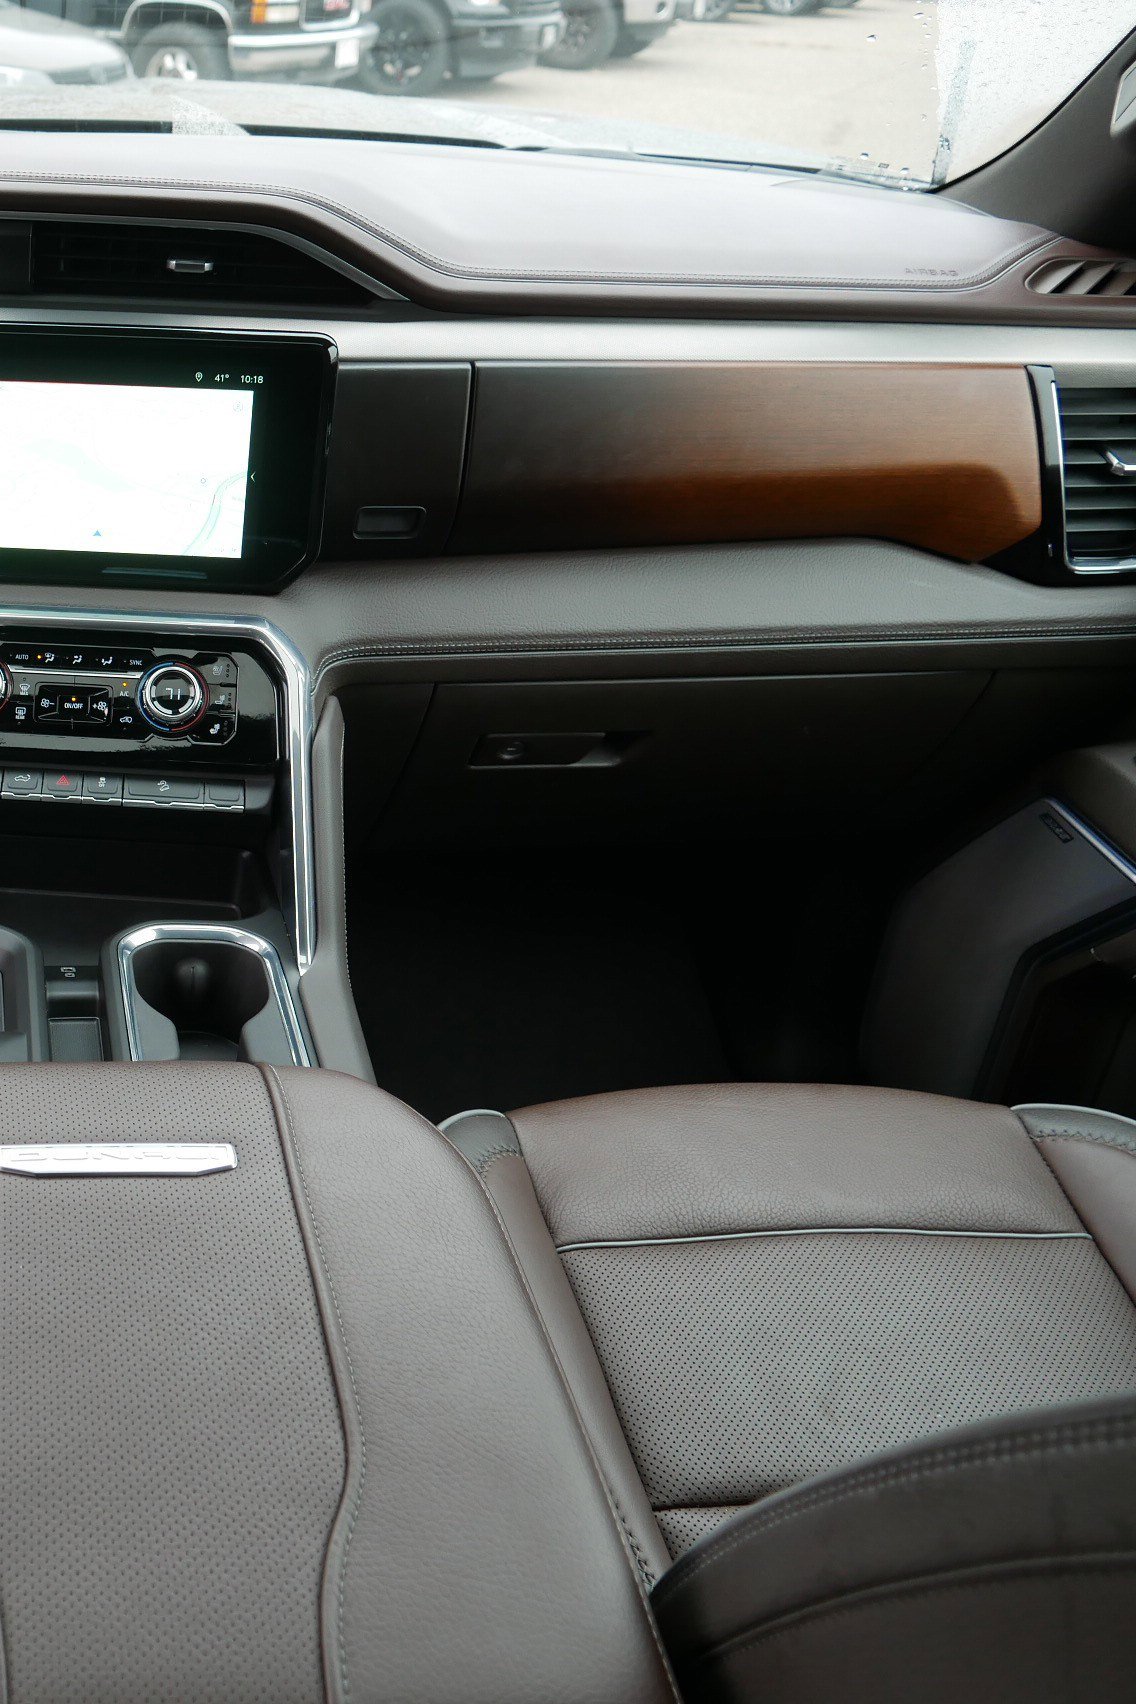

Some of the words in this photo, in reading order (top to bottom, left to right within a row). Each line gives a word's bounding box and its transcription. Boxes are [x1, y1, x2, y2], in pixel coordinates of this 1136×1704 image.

[905, 267, 958, 277] AIRBAG
[214, 373, 230, 382] 41°
[240, 375, 264, 384] 10:18
[15, 653, 29, 661] AUTO
[165, 687, 181, 700] 71
